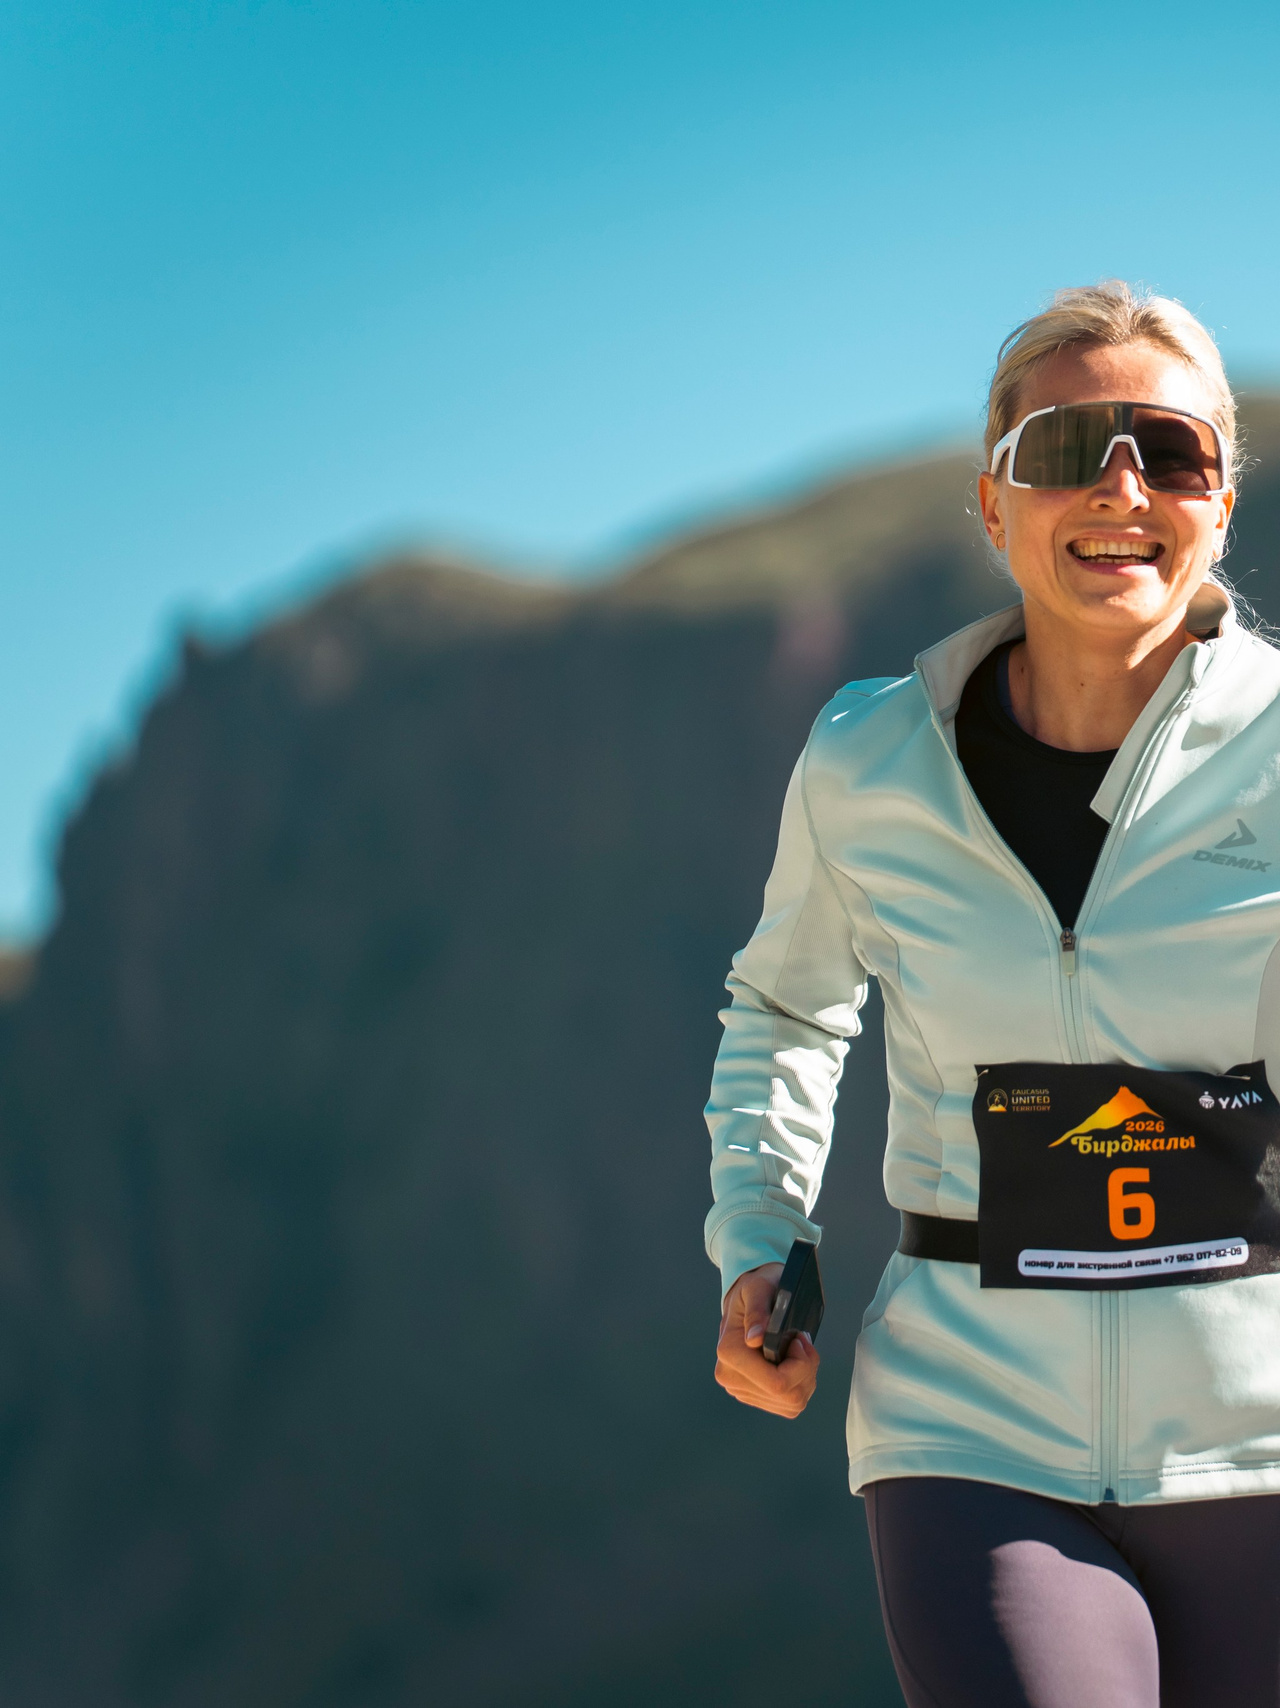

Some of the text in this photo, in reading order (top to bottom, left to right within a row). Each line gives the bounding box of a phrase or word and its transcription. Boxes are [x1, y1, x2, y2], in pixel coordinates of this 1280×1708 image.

[1192, 849, 1272, 873] DEMIX
[1011, 1088, 1050, 1096] CAUCASUS
[1011, 1095, 1051, 1105] UNITED
[1011, 1105, 1052, 1113] TERRITORY
[1125, 1120, 1166, 1133] 2026
[1070, 1134, 1197, 1159] Бирджалы
[1107, 1167, 1156, 1241] 6
[1024, 1260, 1055, 1270] номер
[1056, 1261, 1075, 1270] для
[1077, 1260, 1133, 1272] экстренной
[1134, 1259, 1162, 1268] связи
[1164, 1255, 1175, 1264] +7
